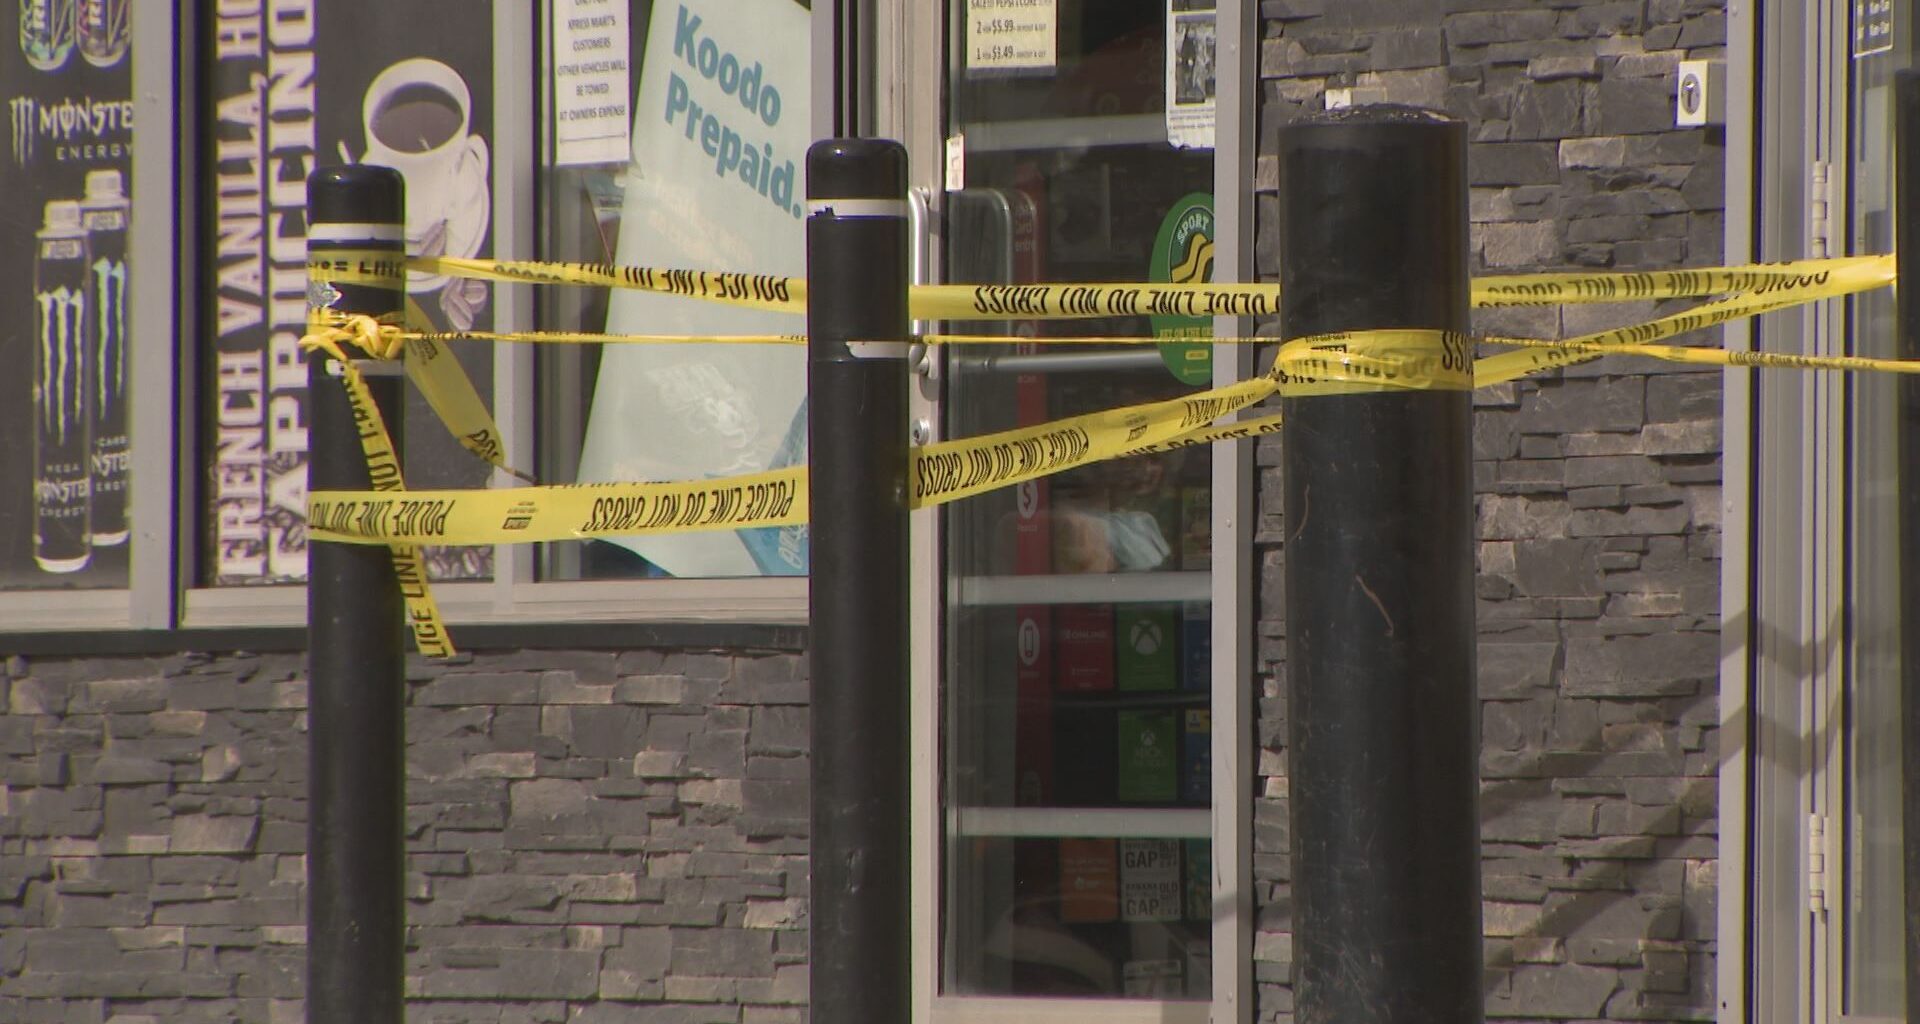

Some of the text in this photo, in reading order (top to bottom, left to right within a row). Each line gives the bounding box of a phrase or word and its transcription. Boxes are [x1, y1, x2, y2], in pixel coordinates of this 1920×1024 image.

[573, 37, 611, 52] CUSTOMERS
[976, 20, 982, 33] 2
[992, 18, 1014, 34] $5.99
[558, 58, 627, 76] OTHER VEHICLES WILL
[673, 3, 781, 127] Koodo
[976, 47, 981, 59] 1
[576, 83, 609, 96] BE TOWED
[38, 97, 133, 138] MONSTE
[560, 104, 625, 121] AT OWNERS EXPENSE
[664, 70, 802, 220] Prepaid.
[217, 70, 267, 342] VANILLA,
[1177, 213, 1209, 245] SPORT
[973, 284, 1051, 315] CROSS
[1058, 286, 1104, 313] NOT
[1146, 288, 1195, 315] LINE
[218, 348, 265, 577] FRENCH
[961, 448, 994, 490] NOT
[995, 442, 1015, 483] DO
[1011, 437, 1046, 478] LINE
[1043, 426, 1090, 474] POLICE
[916, 455, 964, 499] CROSS
[331, 501, 357, 533] DO
[355, 499, 393, 538] LINE
[392, 499, 456, 537] POLICE
[581, 496, 646, 532] CROSS
[651, 494, 681, 531] NOT
[679, 491, 707, 529] DO
[701, 487, 743, 525] LINE
[746, 479, 796, 525] POLICE
[392, 545, 425, 600] LINE
[1125, 850, 1158, 869] GAP
[1126, 898, 1159, 916] GAP
